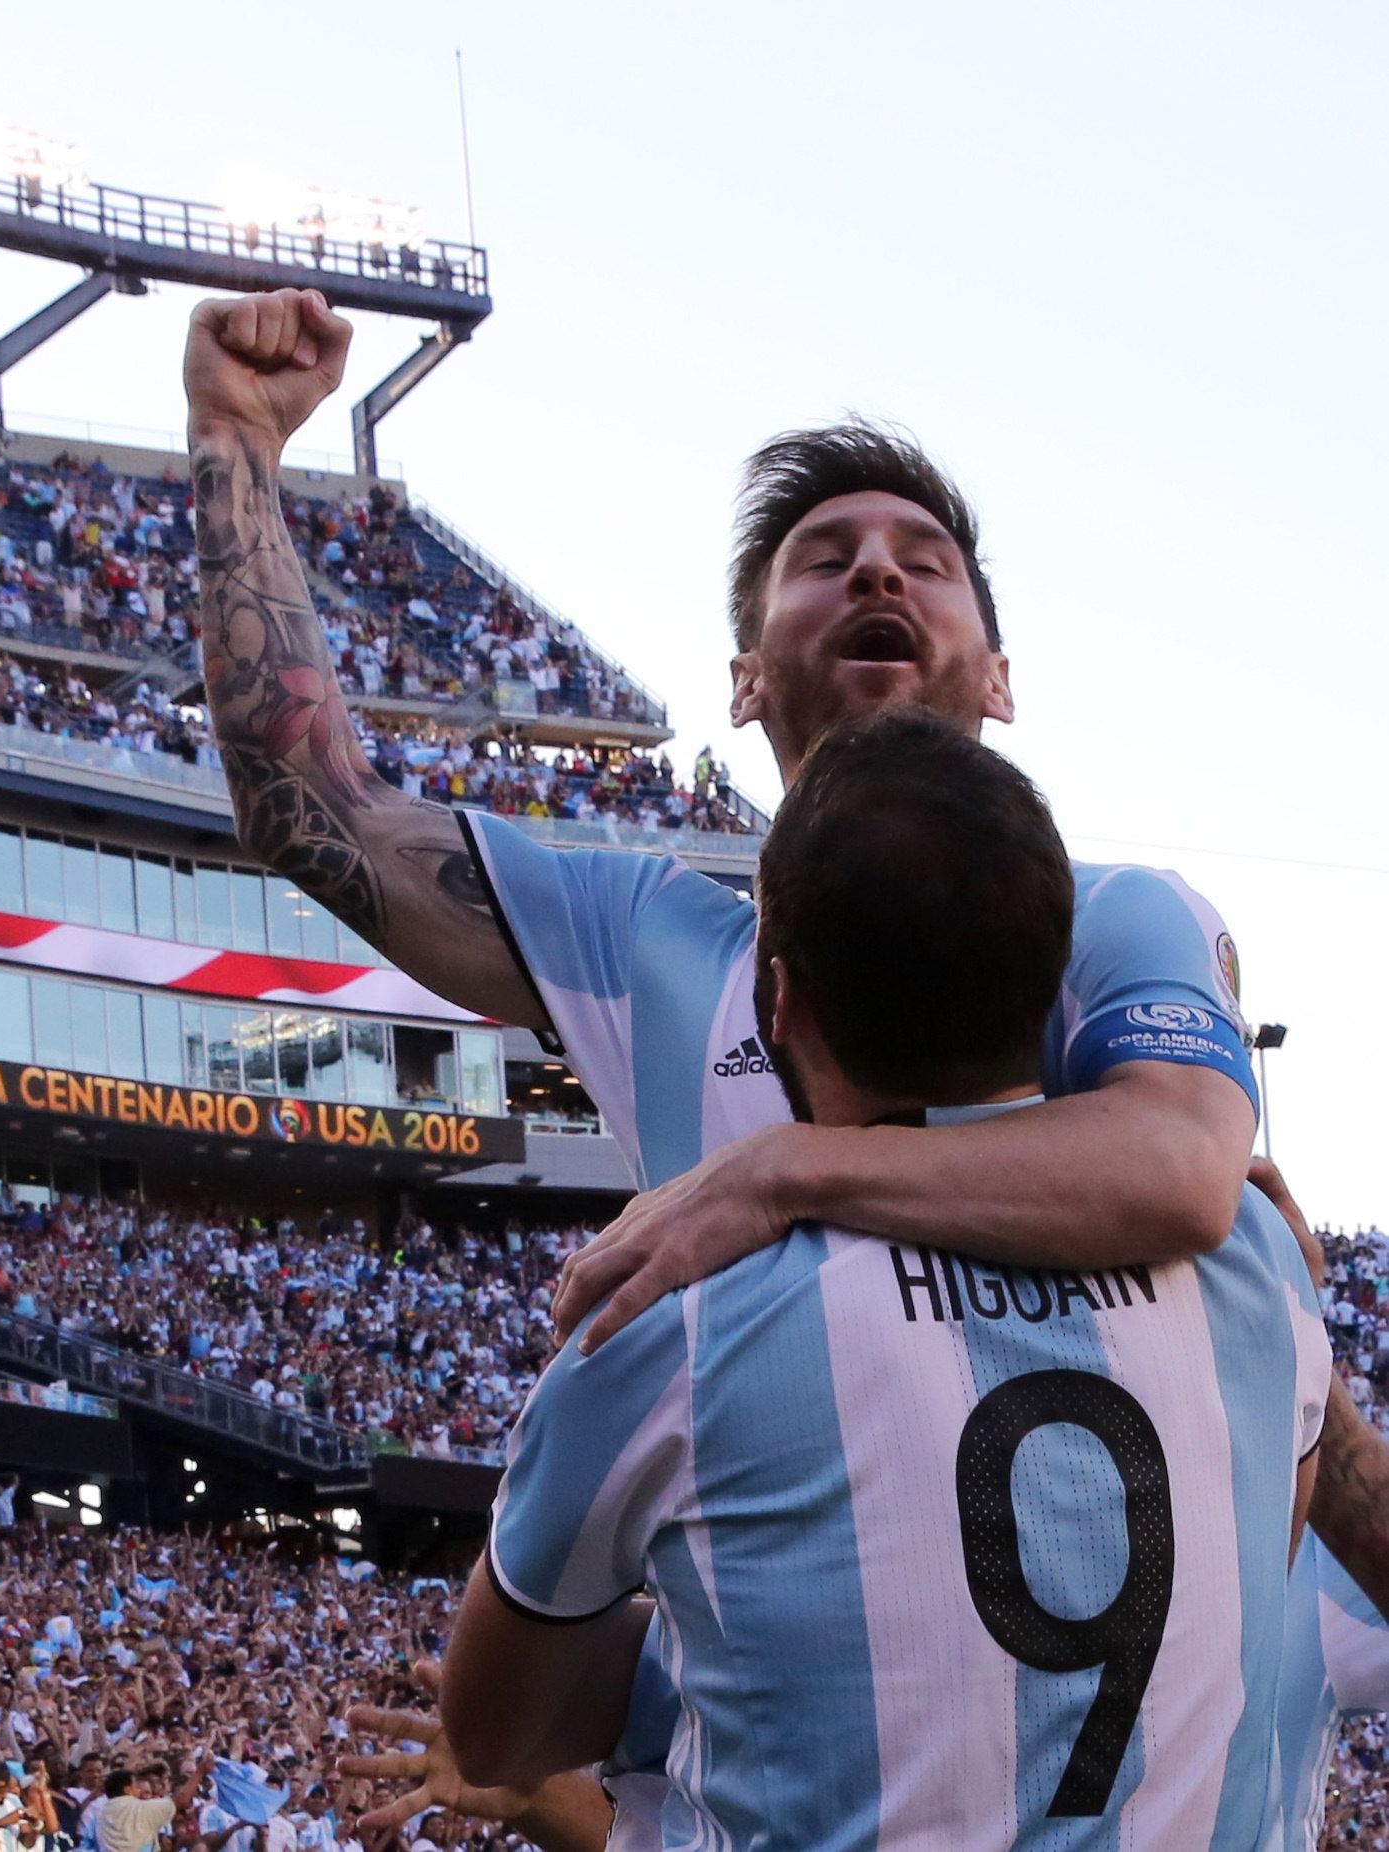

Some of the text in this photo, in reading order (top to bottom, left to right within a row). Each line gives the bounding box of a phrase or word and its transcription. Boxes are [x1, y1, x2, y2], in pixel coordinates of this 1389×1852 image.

[1108, 1032, 1233, 1060] COPA AMERICA
[1150, 1047, 1171, 1055] USA
[713, 1056, 775, 1077] adida
[20, 1067, 259, 1136] CENTENARIO
[318, 1104, 394, 1147] USA
[404, 1110, 480, 1156] 2016
[955, 1368, 1175, 1818] 9
